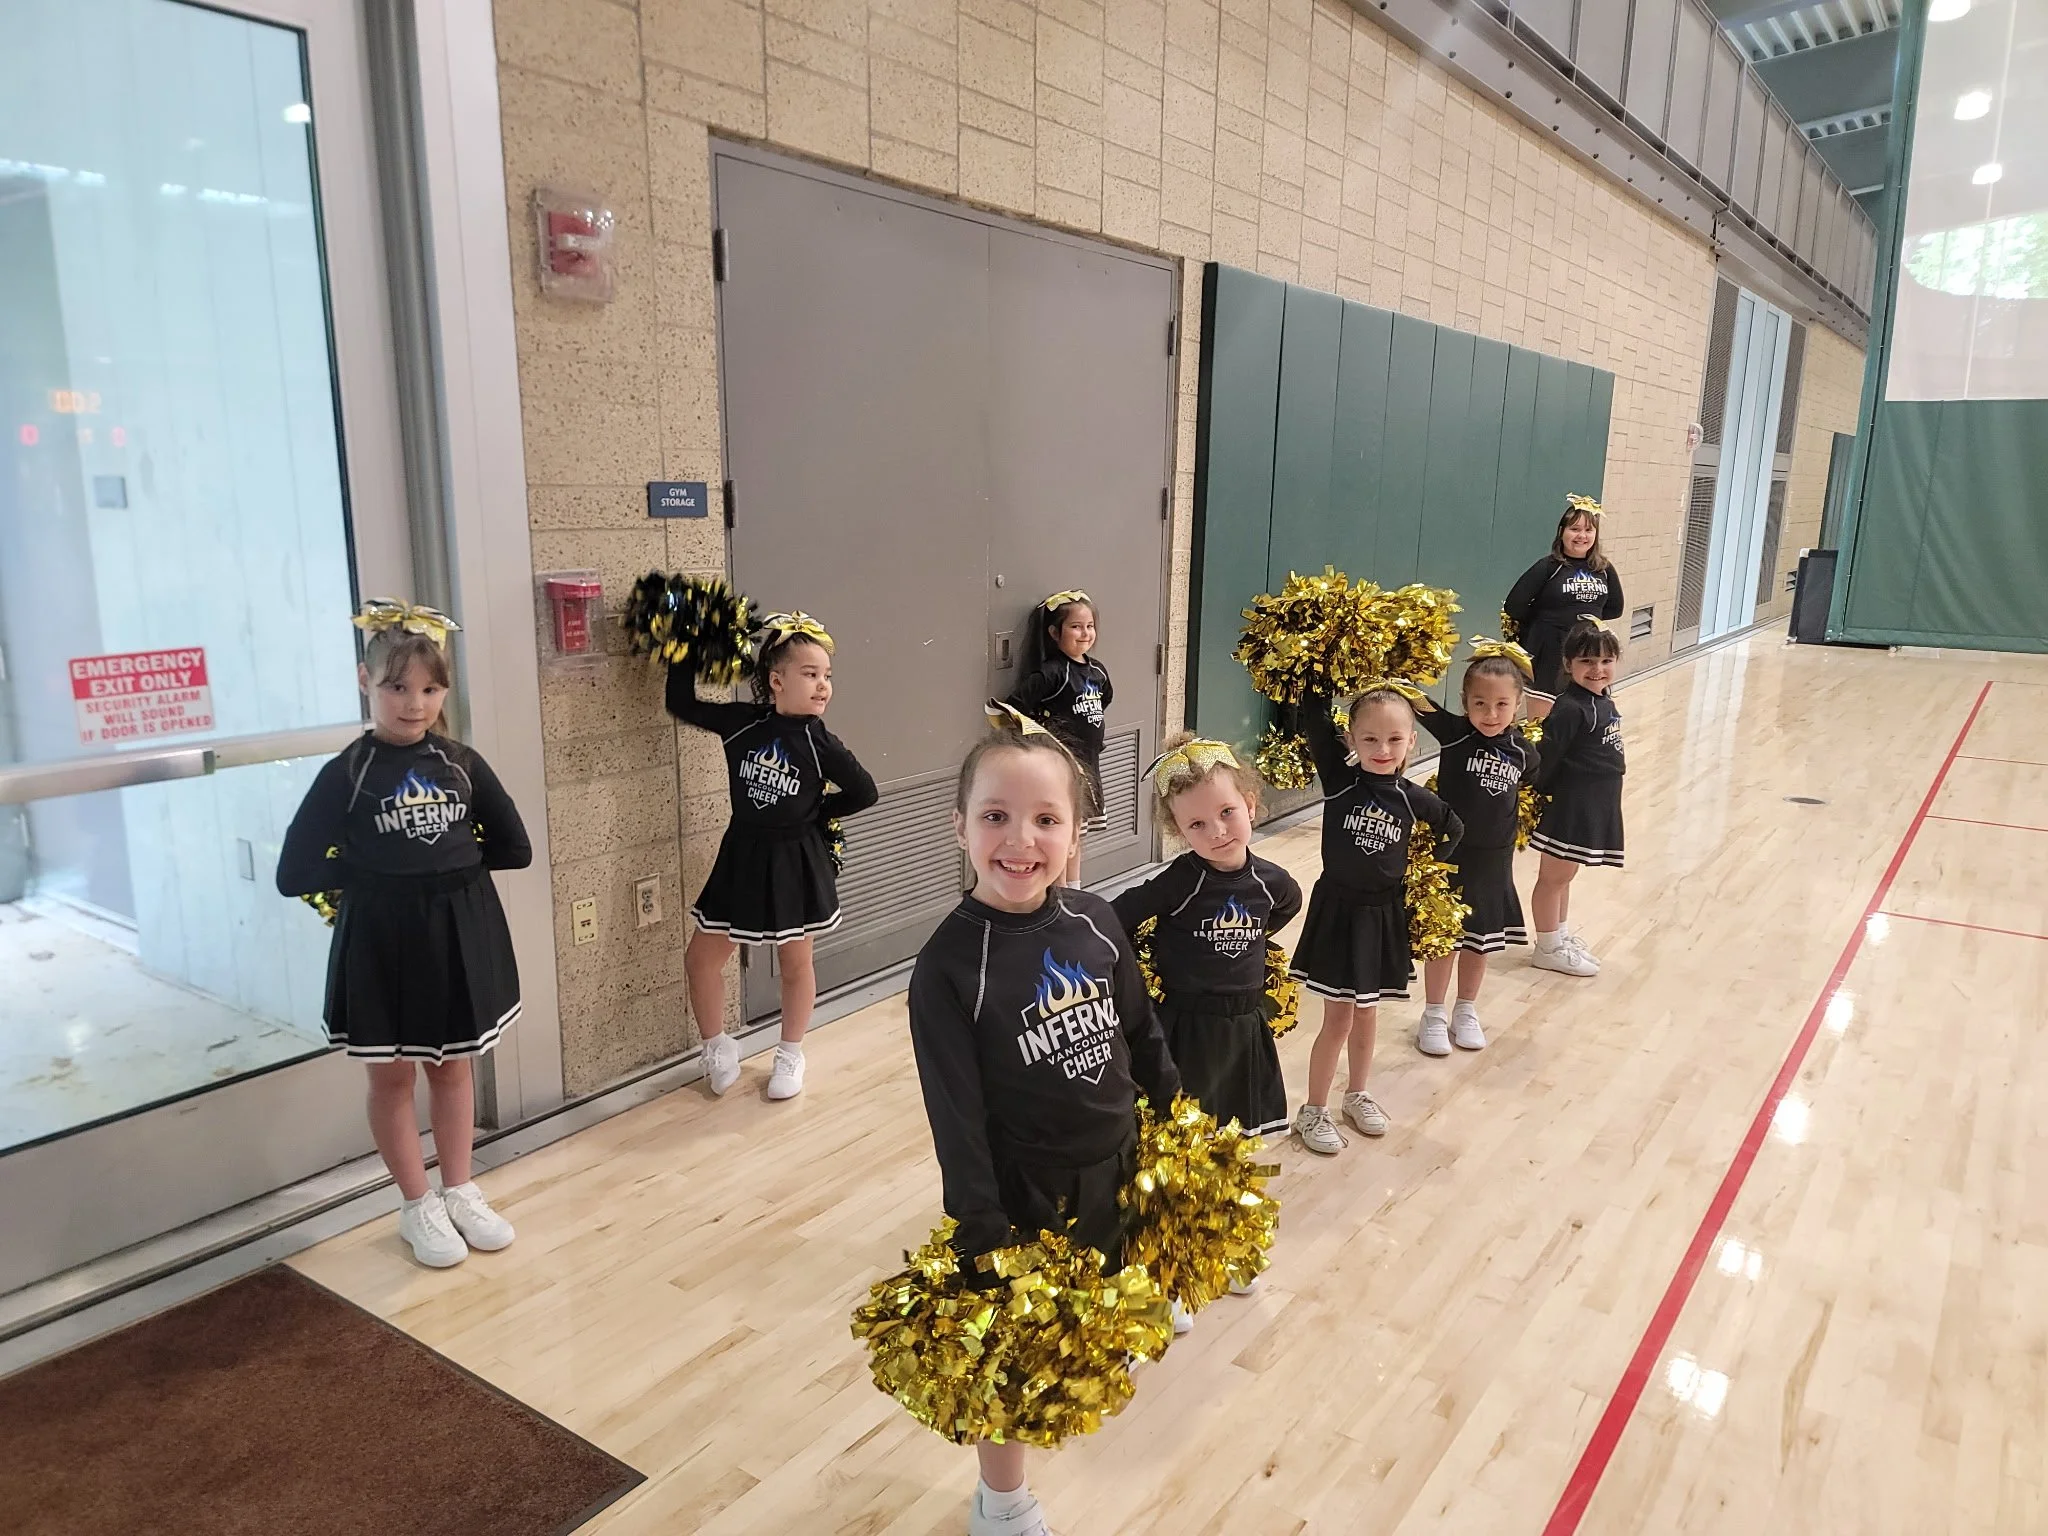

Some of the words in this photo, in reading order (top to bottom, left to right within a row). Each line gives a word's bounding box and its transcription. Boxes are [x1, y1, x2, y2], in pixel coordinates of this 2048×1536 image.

[661, 498, 695, 506] STORAGE
[669, 488, 687, 496] GYM
[1563, 583, 1608, 594] INFERNO
[72, 650, 203, 679] EMERGENCY
[89, 676, 135, 697] EXIT
[139, 671, 192, 690] ONLY
[85, 696, 152, 713] SECURITY
[157, 690, 201, 705] ALARM
[104, 713, 135, 725] WILL
[141, 706, 185, 721] SOUND
[82, 729, 95, 742] IF
[101, 725, 139, 739] DOOR
[144, 723, 156, 733] IS
[161, 716, 211, 731] OPENED
[739, 760, 800, 795] INFERNO
[1466, 758, 1522, 784] INFERNO
[745, 780, 786, 797] VANCOUVER
[1480, 779, 1508, 792] CHEER
[748, 788, 778, 805] CHEER
[375, 803, 467, 834] INFERNO
[1343, 814, 1401, 842] INFERNO
[406, 822, 449, 839] CHEER
[1351, 831, 1392, 844] VANCOUVER
[1355, 837, 1385, 851] CHEER
[1215, 941, 1249, 951] CHEER
[1017, 997, 1119, 1066] INFERNO
[1046, 1030, 1115, 1065] VANCOUVER
[1062, 1042, 1112, 1080] CHEER
